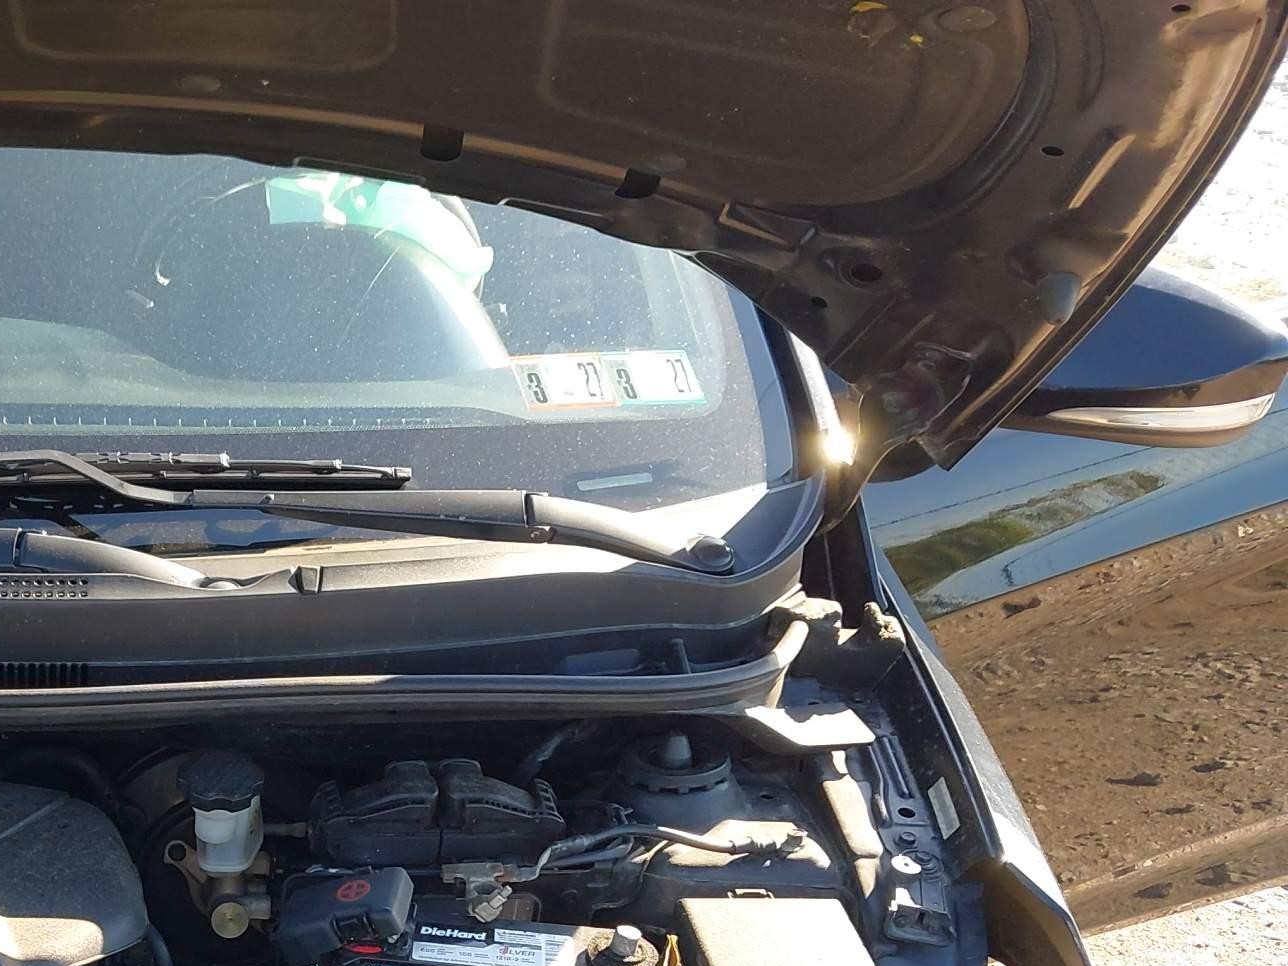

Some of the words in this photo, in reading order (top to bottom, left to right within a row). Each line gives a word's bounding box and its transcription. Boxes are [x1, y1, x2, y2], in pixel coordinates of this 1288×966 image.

[526, 372, 549, 404] 3
[577, 362, 604, 399] 27
[616, 368, 638, 400] 3
[666, 358, 692, 393] 27
[420, 926, 487, 941] DieHard
